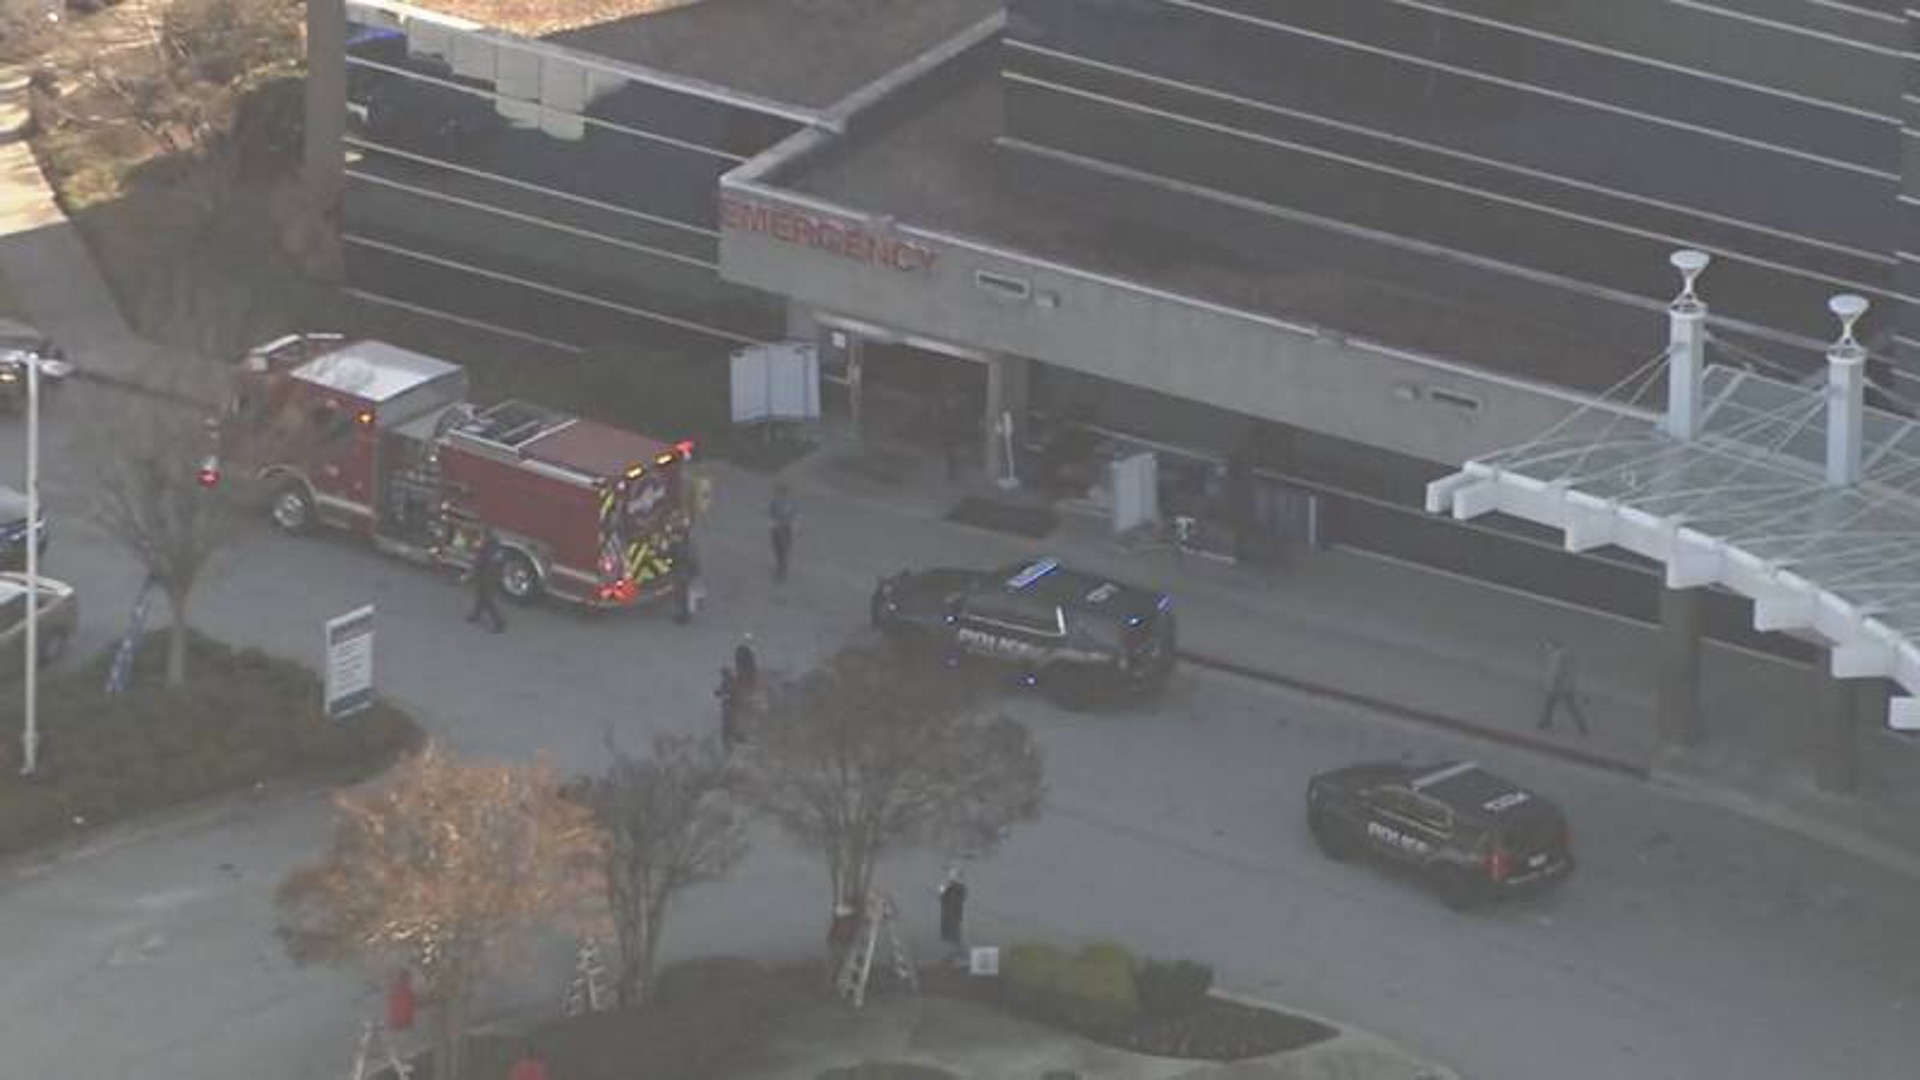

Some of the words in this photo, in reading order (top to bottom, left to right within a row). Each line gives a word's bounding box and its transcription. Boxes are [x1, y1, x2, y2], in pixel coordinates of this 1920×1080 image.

[722, 199, 940, 271] EMERGENCY
[958, 627, 1036, 657] POLICE
[1367, 821, 1431, 853] POLICE
